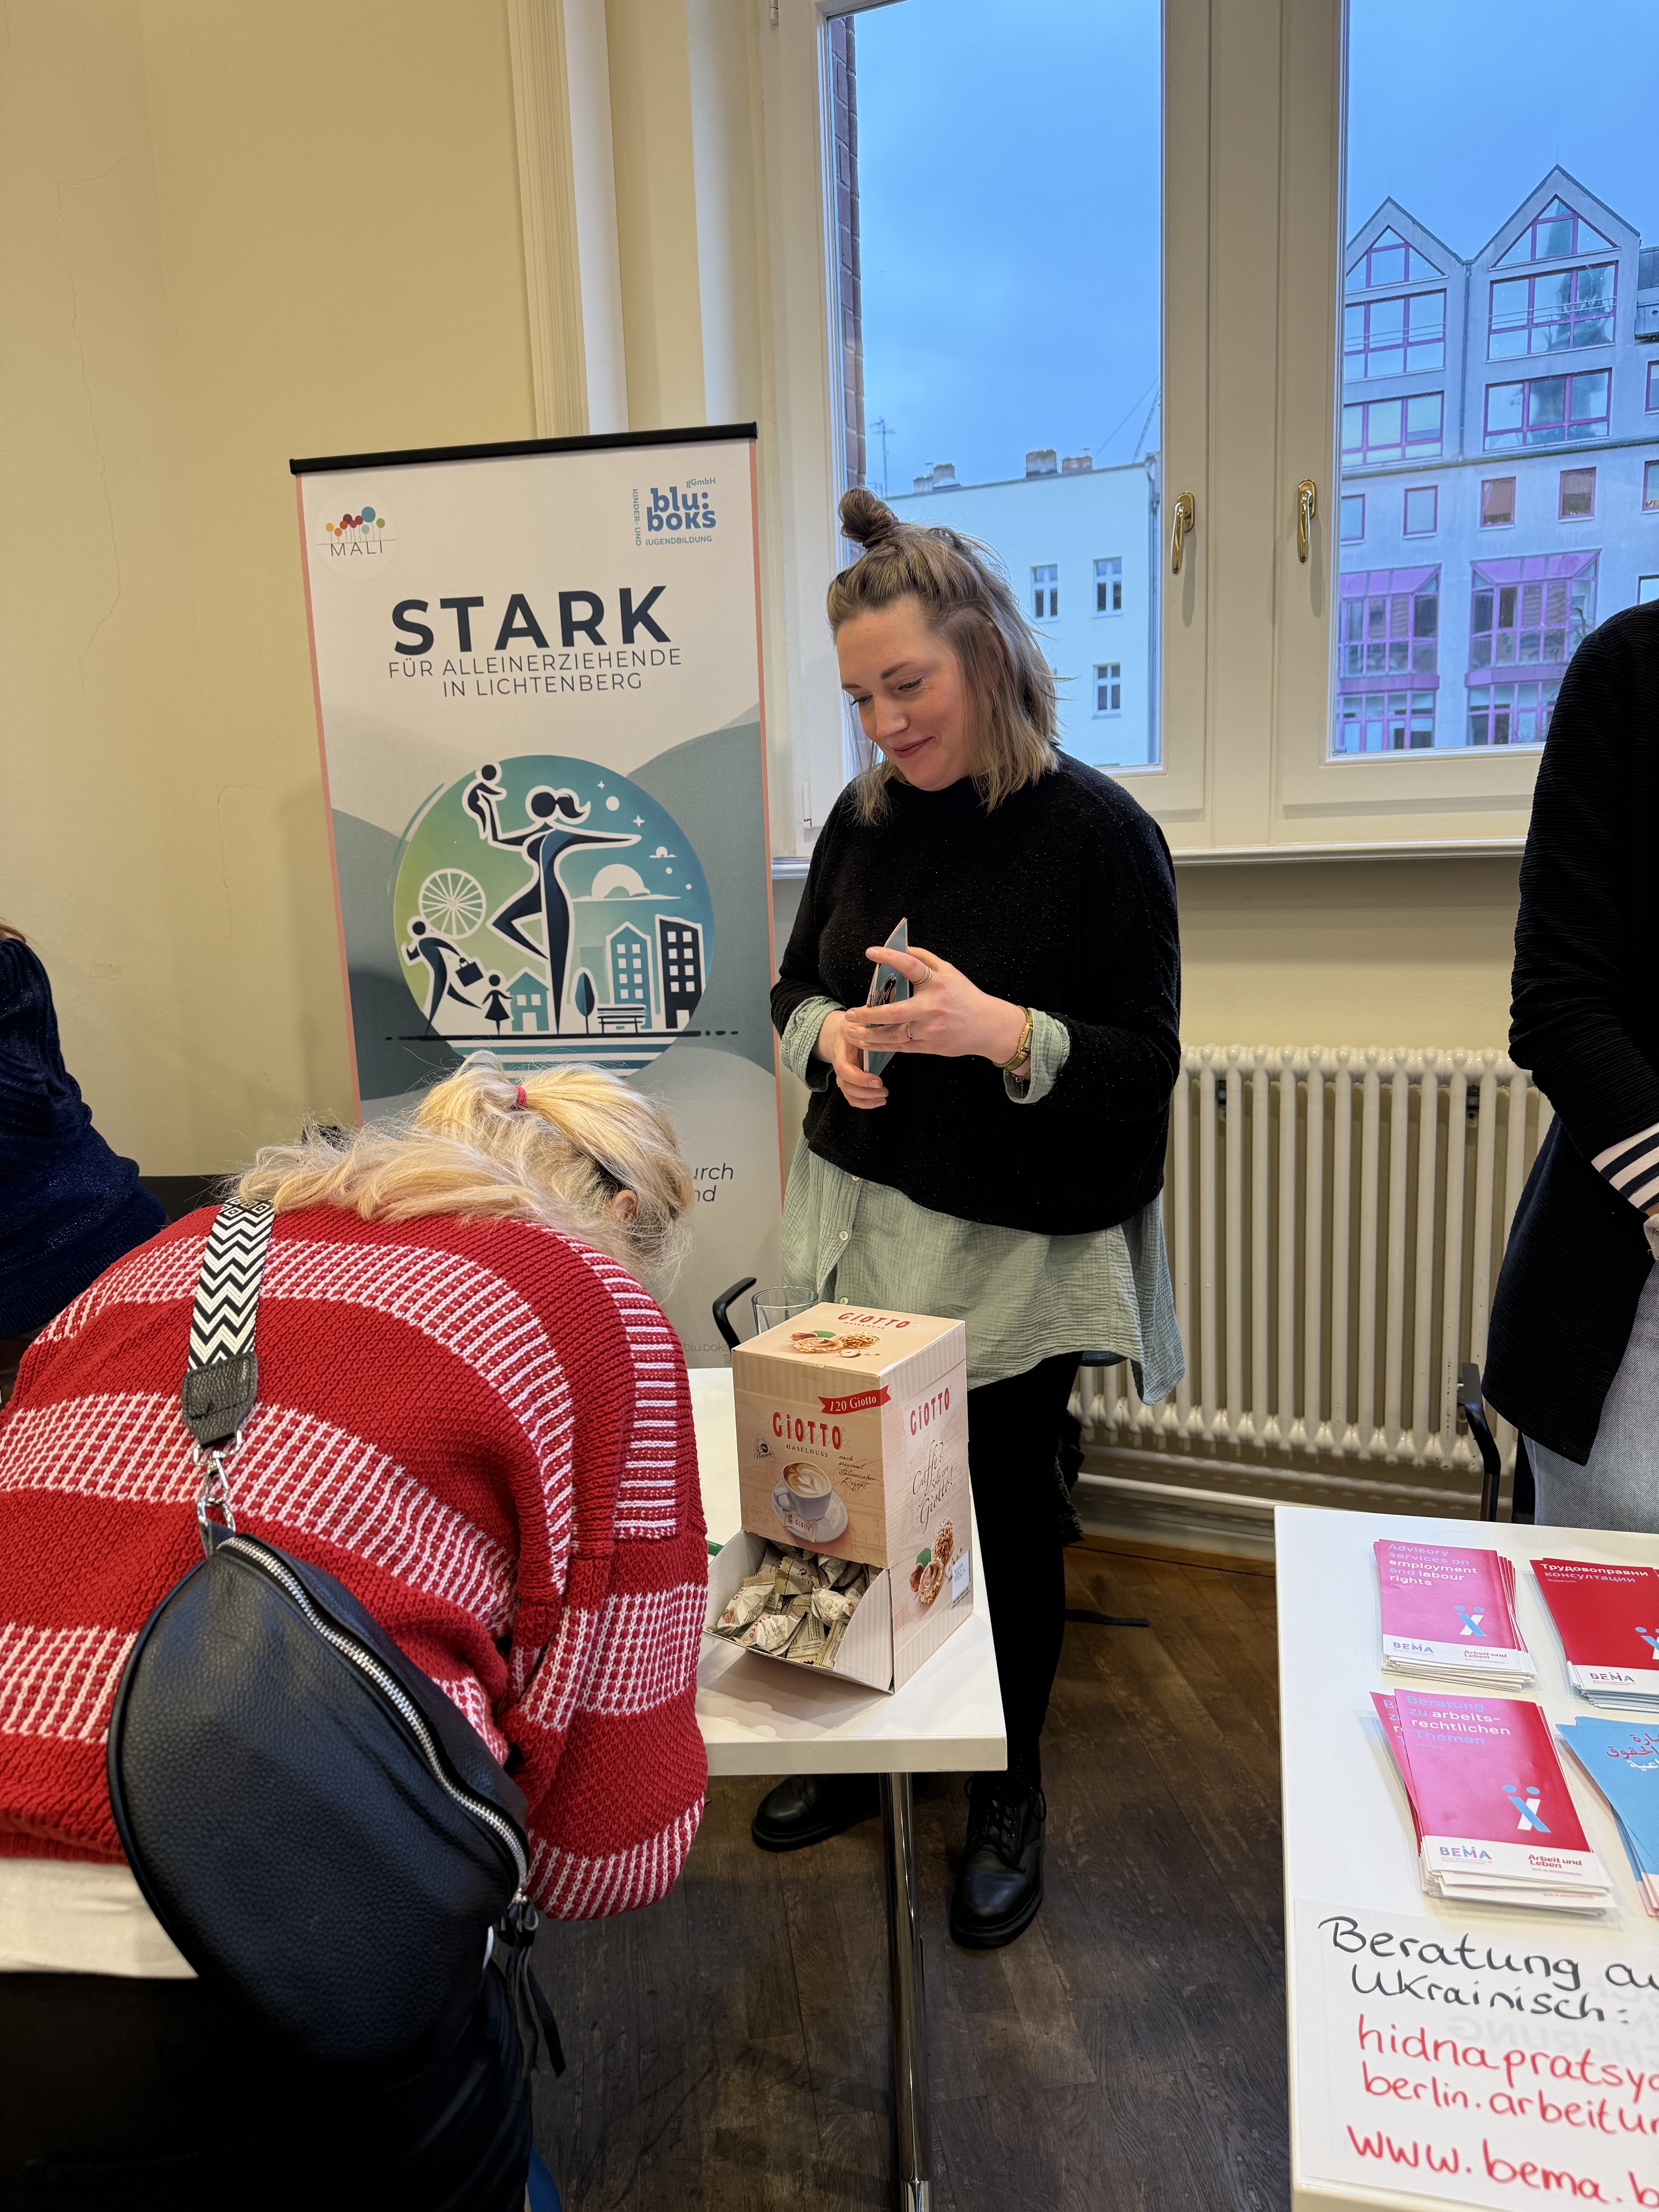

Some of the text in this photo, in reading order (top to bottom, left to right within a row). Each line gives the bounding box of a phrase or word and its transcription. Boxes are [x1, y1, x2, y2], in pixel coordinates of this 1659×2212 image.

[686, 477, 716, 488] gGmbH
[646, 536, 712, 546] JUGENDBILDUNG
[331, 540, 382, 556] MALI
[392, 586, 671, 655] STARK
[389, 648, 682, 678] FÜR ALLEINERZIEHENDE
[444, 673, 642, 697] IN LICHTENBERG
[830, 1396, 876, 1412] 120 Giotto
[787, 1444, 828, 1457] HASELNUSS
[839, 1462, 866, 1472] original
[1388, 1544, 1448, 1556] Advisory
[1389, 1553, 1448, 1563] services
[1389, 1560, 1477, 1574] employment
[1390, 1575, 1432, 1585] rights
[1419, 1570, 1465, 1580] labour
[1406, 1696, 1484, 1712] Beratung
[1432, 1711, 1501, 1722] arbeits-
[1412, 1719, 1510, 1735] rechtlichen
[1415, 1729, 1485, 1745] Themen
[1528, 1854, 1561, 1863] Arbeit
[1530, 1860, 1561, 1868] Leben
[1318, 1915, 1580, 1990] Beratung
